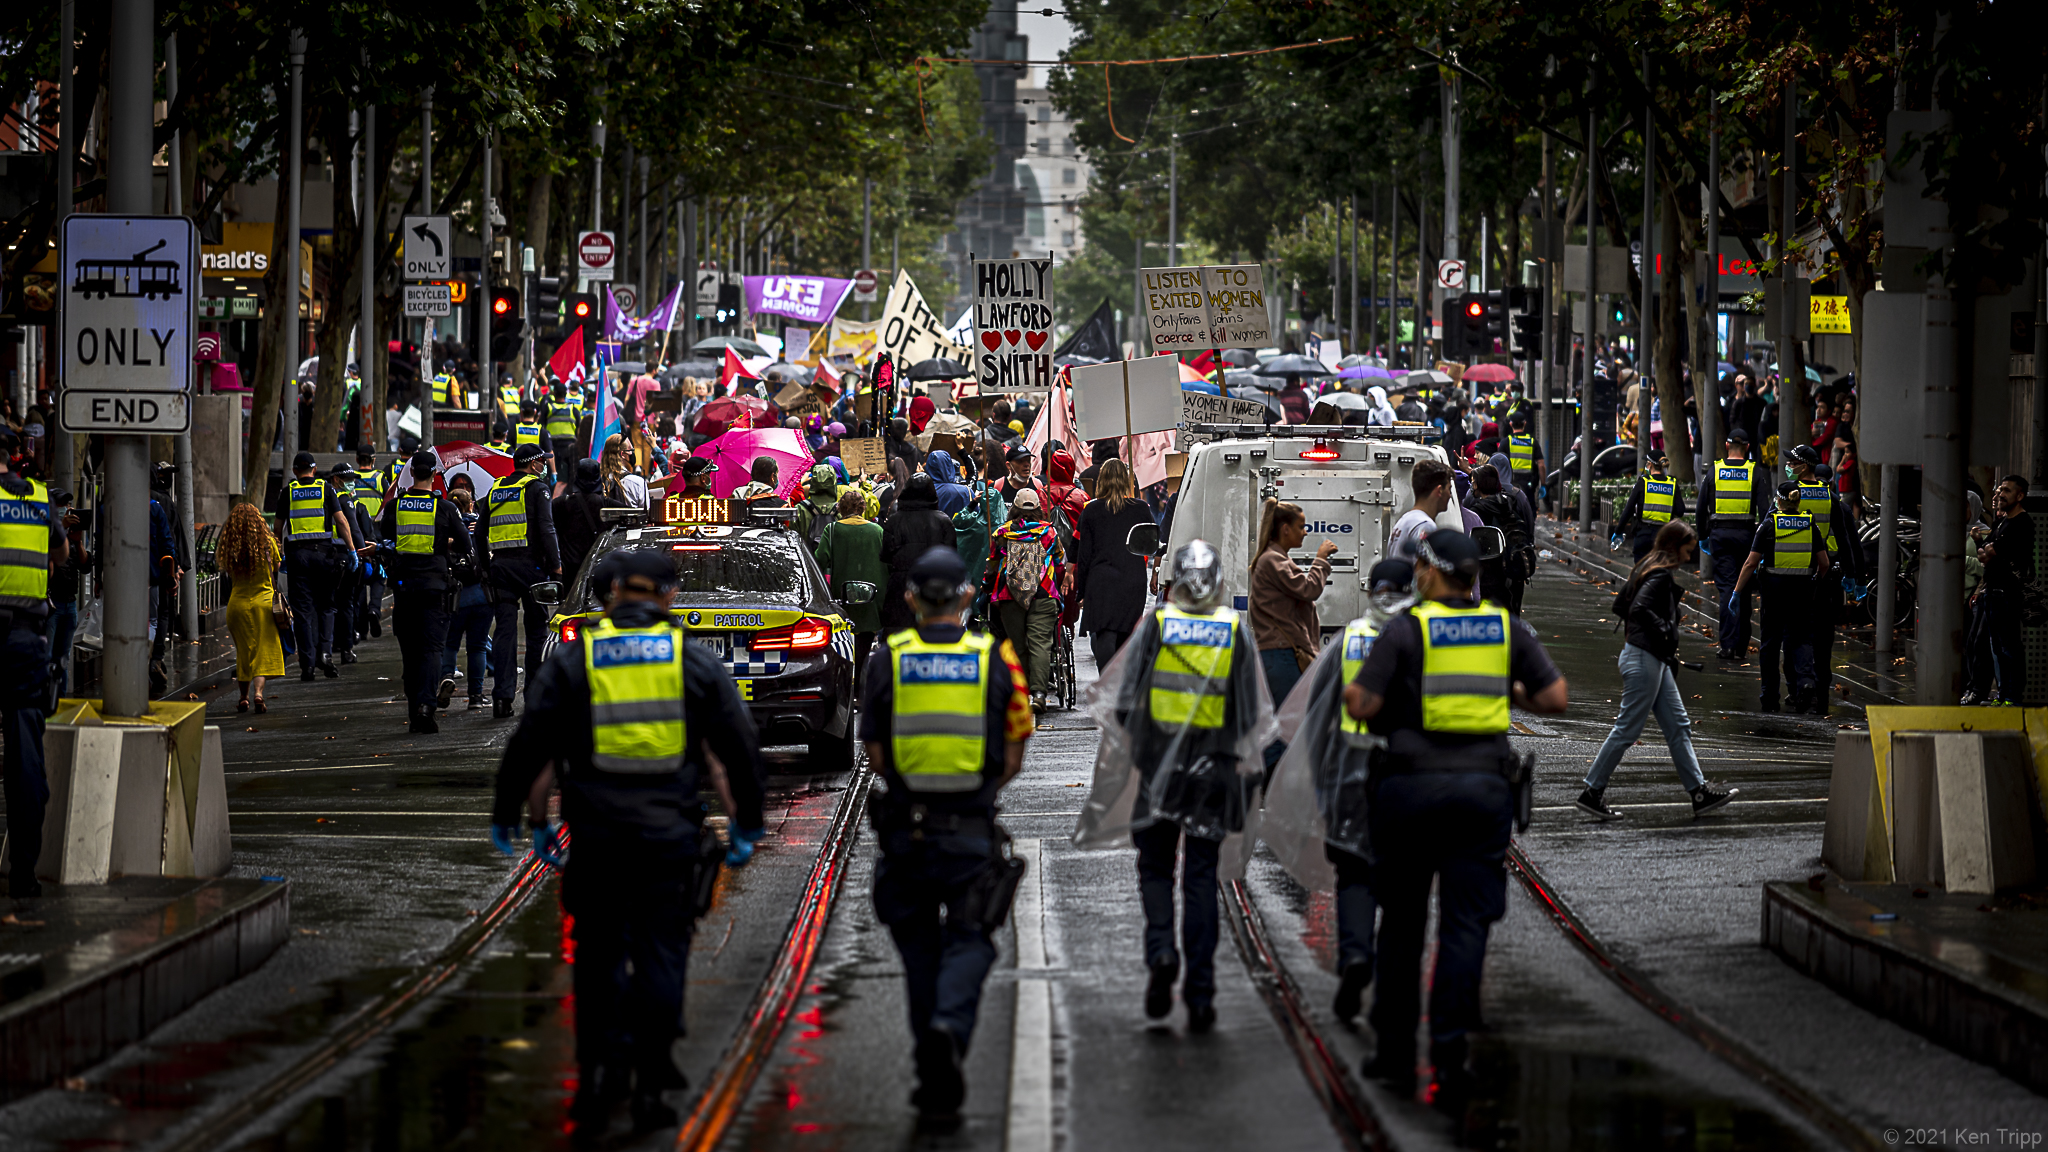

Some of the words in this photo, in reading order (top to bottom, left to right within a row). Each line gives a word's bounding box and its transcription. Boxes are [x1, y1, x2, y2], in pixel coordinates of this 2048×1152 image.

[202, 251, 267, 269] nald's
[408, 262, 446, 273] ONLY
[979, 261, 1051, 300] HOLLY
[1146, 271, 1201, 290] LISTEN
[1216, 269, 1248, 286] TO
[408, 291, 447, 299] BICYCLES
[616, 296, 631, 306] 30
[1150, 292, 1202, 310] EXITED
[1207, 290, 1263, 314] WOMEN
[407, 303, 447, 311] EXCEPTED
[978, 302, 1052, 330] LAWFORD
[1212, 314, 1243, 327] johns
[885, 316, 921, 354] OF
[1155, 333, 1194, 345] coerce
[1209, 327, 1227, 343] kill
[1231, 330, 1268, 342] women
[77, 327, 175, 366] ONLY
[92, 398, 159, 423] END
[1183, 392, 1228, 412] WOMEN
[1232, 401, 1257, 416] HAVE
[1257, 405, 1264, 418] A
[1183, 408, 1220, 423] RIGHT
[1719, 470, 1747, 479] Police
[293, 490, 321, 498] Police
[492, 490, 519, 500] Police
[1648, 484, 1672, 493] Police
[1800, 488, 1828, 497] Police
[1, 503, 47, 521] Police
[400, 499, 433, 510] Police
[665, 498, 729, 522] DOWN
[1303, 521, 1353, 533] olice
[1778, 518, 1809, 527] Police
[714, 614, 764, 626] PATROL
[1165, 620, 1229, 644] Police
[1431, 618, 1500, 641] Police
[595, 637, 671, 661] Police
[902, 655, 977, 679] Police
